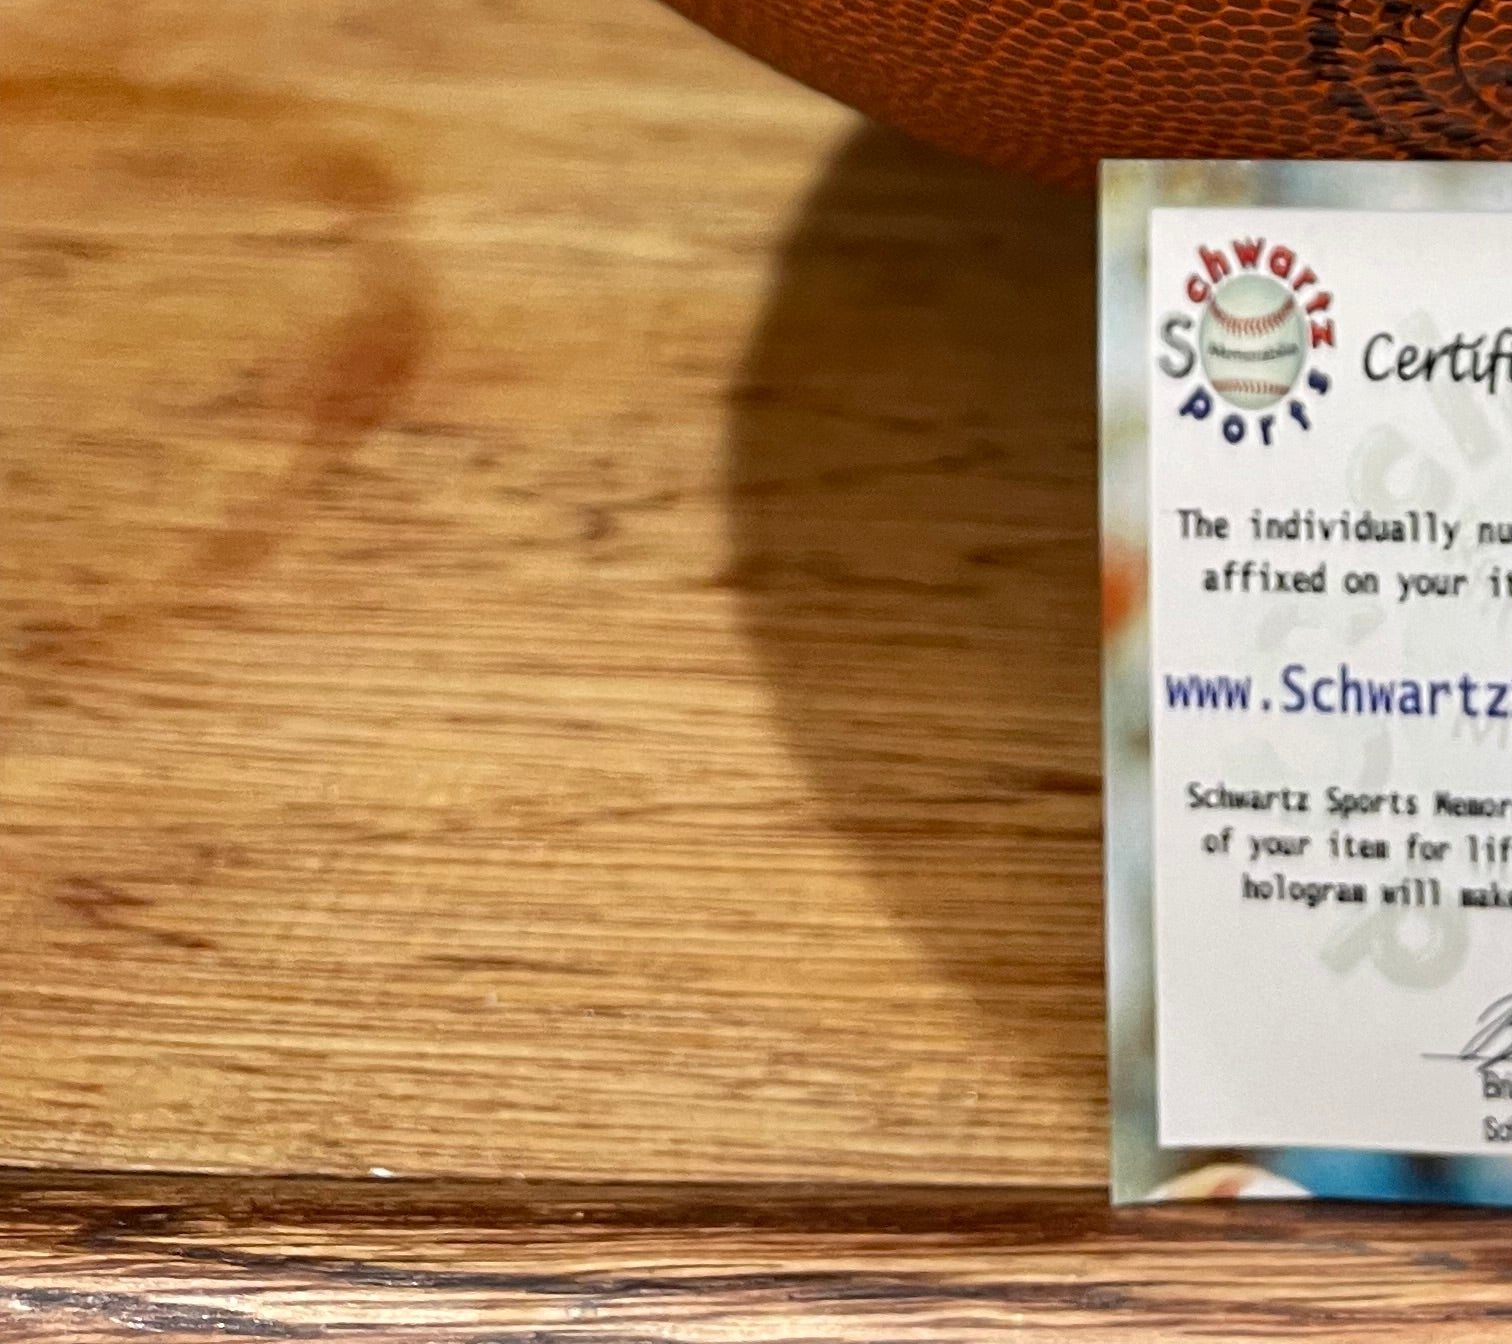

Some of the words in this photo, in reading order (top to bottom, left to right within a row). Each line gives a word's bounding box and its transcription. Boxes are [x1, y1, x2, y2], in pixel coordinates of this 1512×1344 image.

[1175, 508, 1229, 540] The
[1251, 509, 1460, 550] individually
[1203, 560, 1328, 594] affixed
[1344, 572, 1380, 596] on
[1397, 573, 1467, 602] your
[1186, 782, 1311, 813] Schwartz
[1326, 786, 1419, 819] Sports
[1203, 825, 1234, 854] of
[1249, 832, 1312, 861] your
[1328, 829, 1389, 859] item
[1407, 831, 1451, 861] for
[1242, 871, 1368, 907] hologram
[1380, 876, 1441, 907] will
